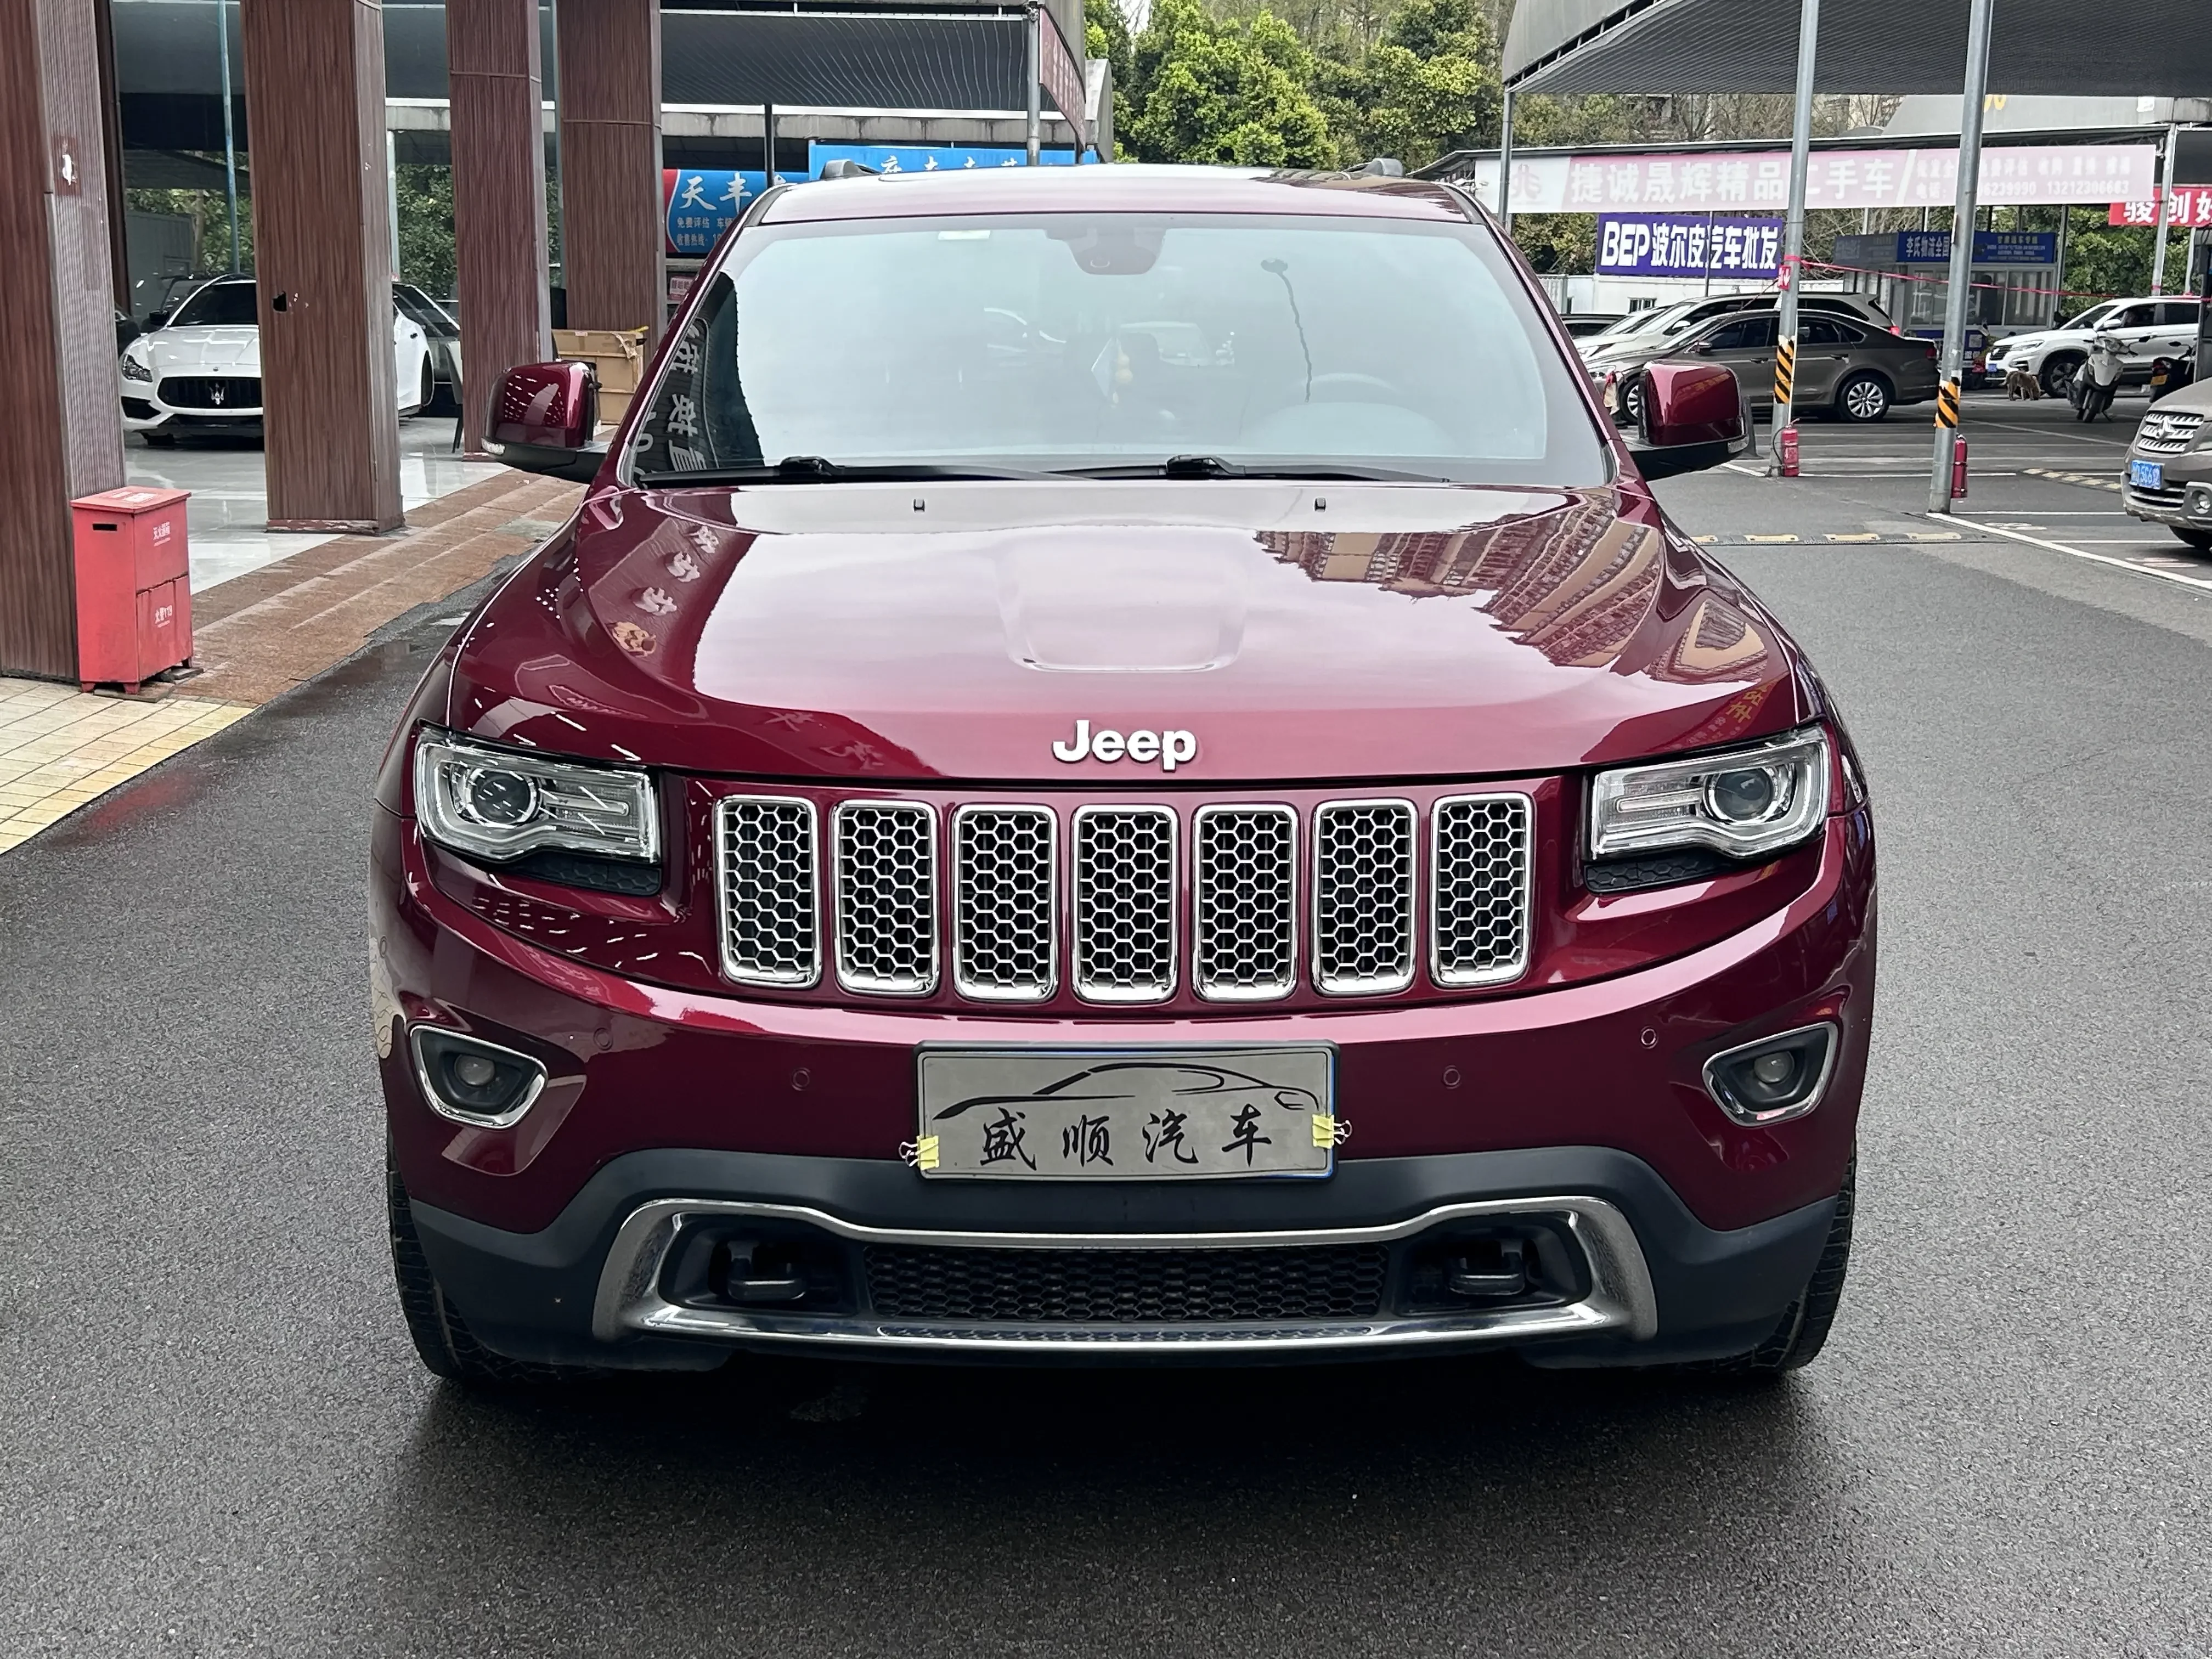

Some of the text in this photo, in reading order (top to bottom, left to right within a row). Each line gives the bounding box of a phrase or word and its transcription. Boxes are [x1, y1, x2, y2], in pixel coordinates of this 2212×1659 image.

[1052, 719, 1197, 771] Jeep
[980, 1103, 1272, 1171] 盛顺汽车
